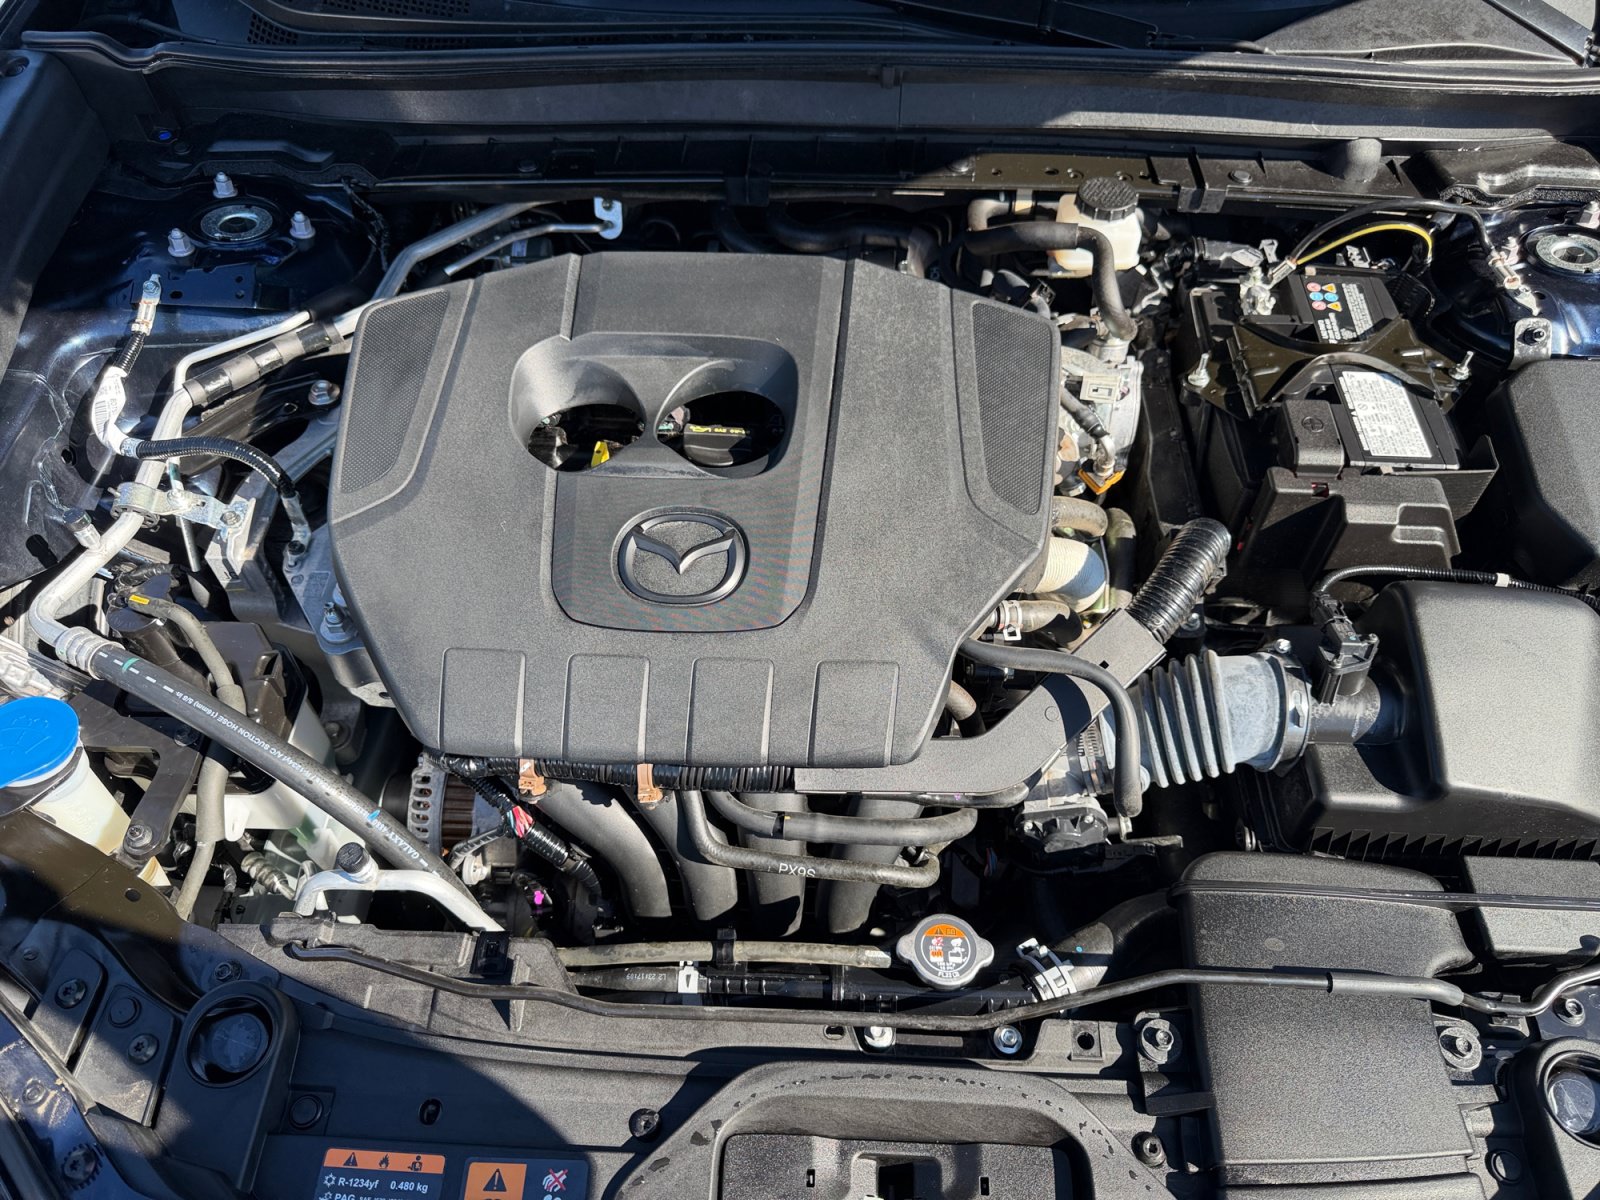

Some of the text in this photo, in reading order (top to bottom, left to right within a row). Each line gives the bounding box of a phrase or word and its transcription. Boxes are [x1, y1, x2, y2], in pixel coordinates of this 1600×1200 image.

[193, 701, 219, 719] (16mm)
[216, 715, 239, 732] HOSE
[238, 727, 270, 751] SUCTION
[269, 748, 284, 759] A/C
[387, 832, 420, 859] GALAXY
[338, 1177, 428, 1194] R-1234yf 0.480 kg
